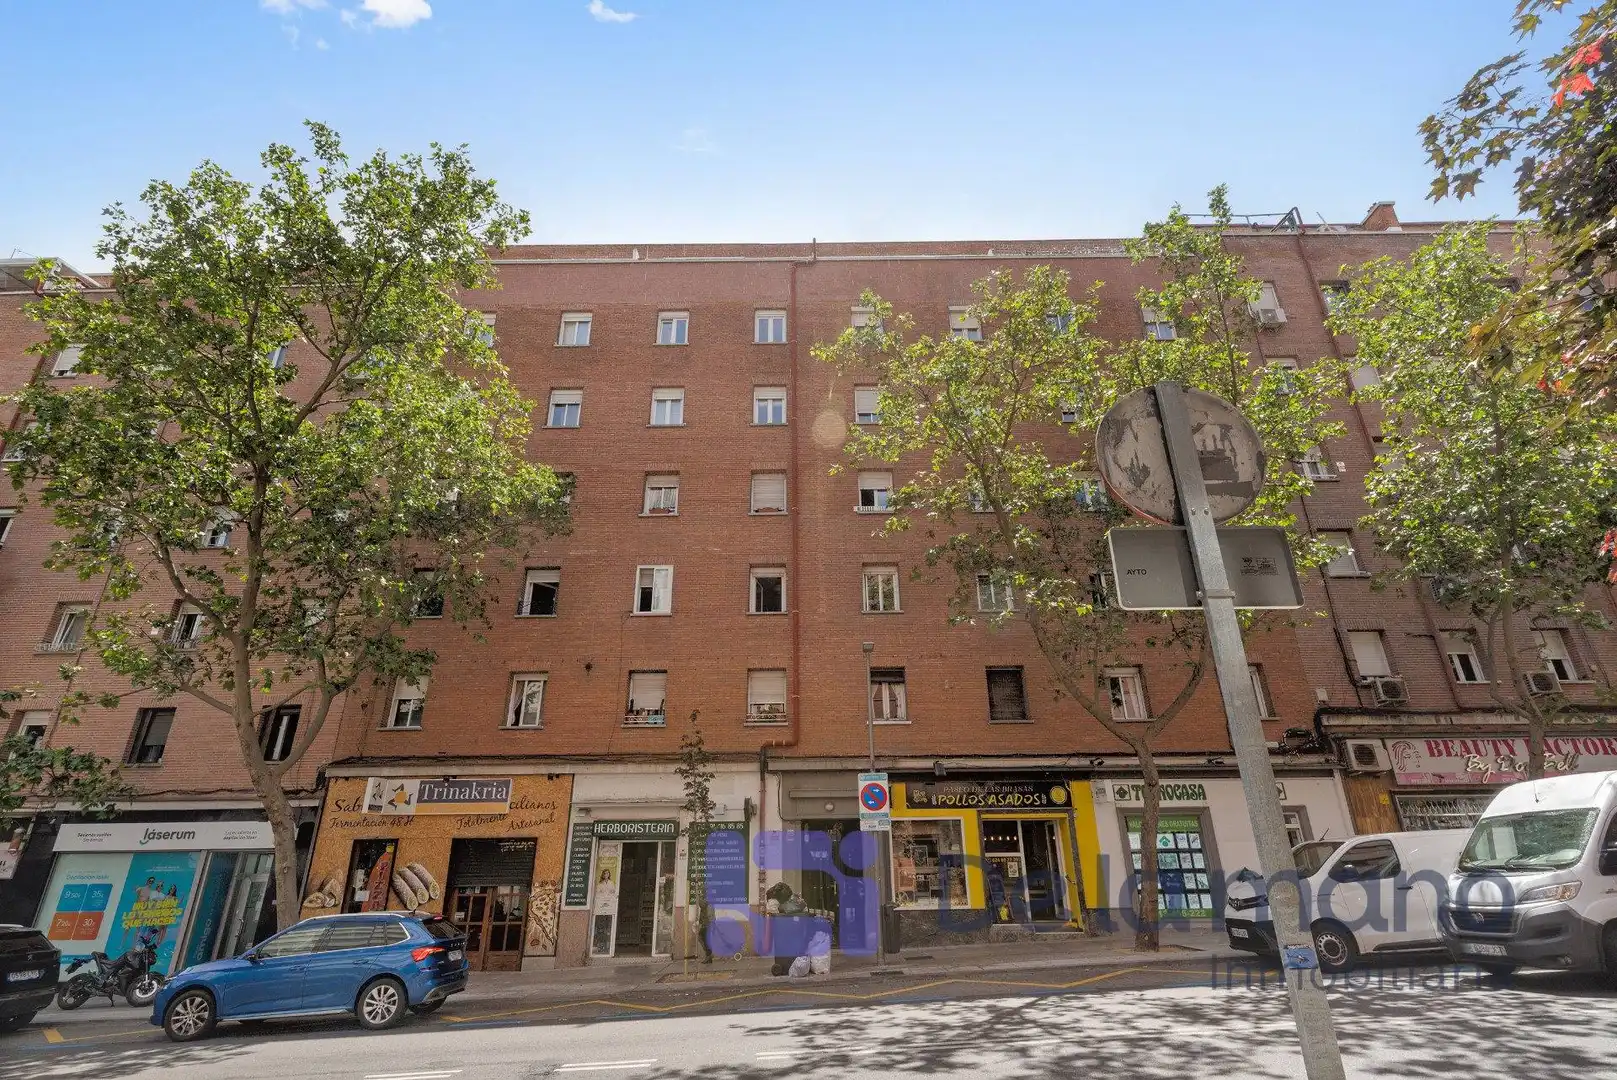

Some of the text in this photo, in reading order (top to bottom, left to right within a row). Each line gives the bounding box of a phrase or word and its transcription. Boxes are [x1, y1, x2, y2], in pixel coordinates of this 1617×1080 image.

[1126, 568, 1147, 576] AYTO
[1424, 738, 1517, 759] BEAUTY
[1464, 753, 1496, 784] By
[420, 782, 508, 800] Trinakria
[1002, 785, 1034, 793] BRASAS
[1131, 784, 1207, 800] TNOCASA
[508, 795, 559, 811] cilianos
[938, 793, 1041, 806] POLLOS ASADOS
[139, 827, 196, 845] láserum
[594, 823, 675, 834] HERBORISTERIA
